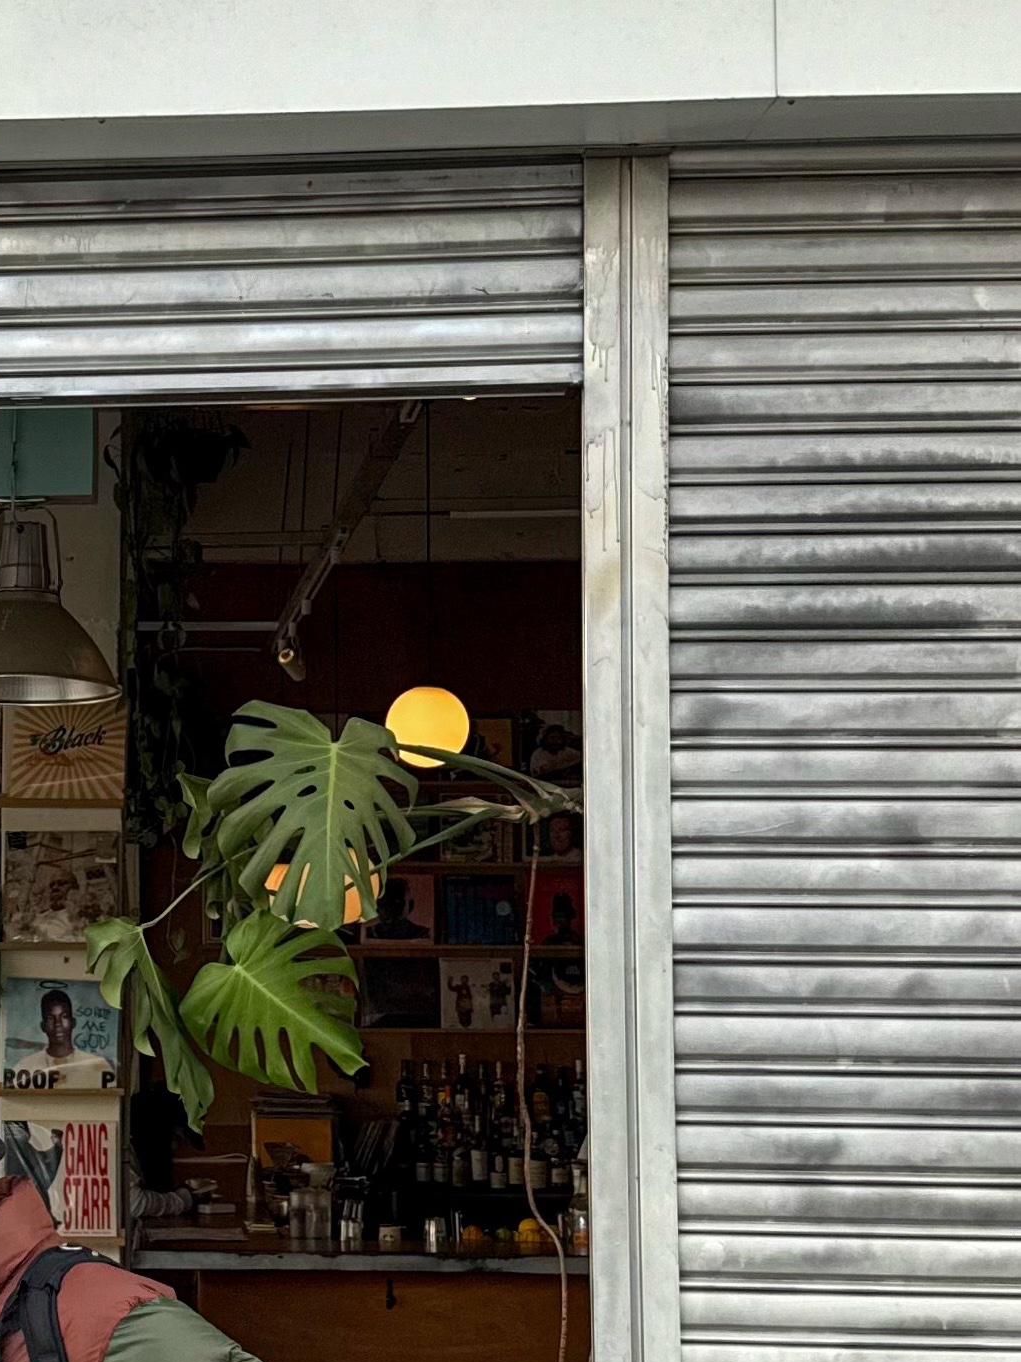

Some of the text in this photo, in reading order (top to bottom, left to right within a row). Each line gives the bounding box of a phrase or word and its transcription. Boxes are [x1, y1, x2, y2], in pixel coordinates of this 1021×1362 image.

[39, 724, 107, 756] Black
[82, 1020, 107, 1032] ME
[3, 1068, 61, 1089] ROOF
[65, 1123, 108, 1177] GANG
[63, 1177, 111, 1230] STARR
